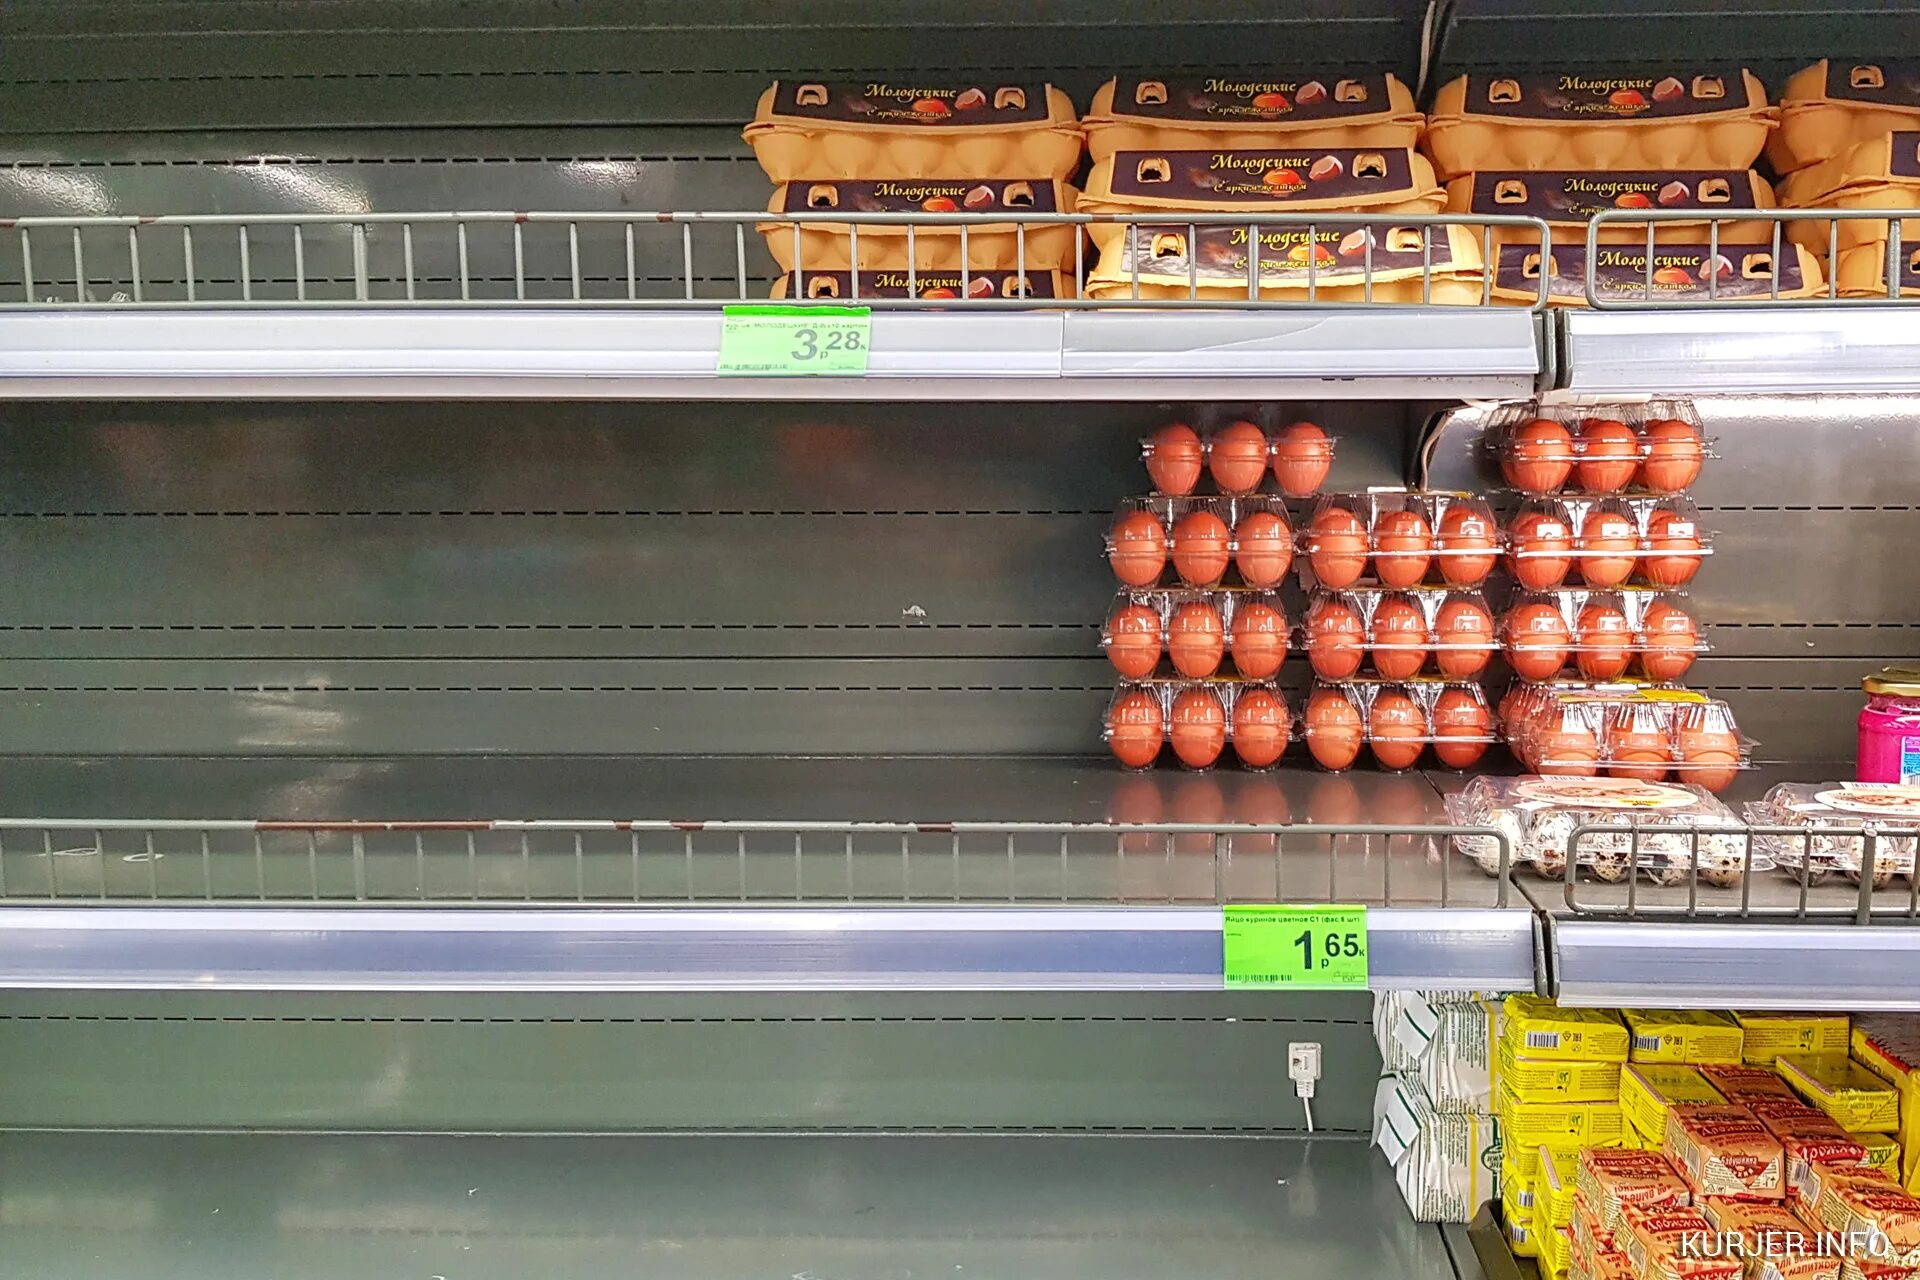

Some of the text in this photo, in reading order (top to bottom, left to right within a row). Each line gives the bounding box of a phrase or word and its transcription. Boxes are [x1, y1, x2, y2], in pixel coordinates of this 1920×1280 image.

[864, 83, 957, 103] Молодецкие
[1204, 78, 1297, 99] Молодецкие
[1558, 76, 1654, 96] Молодецкие
[1209, 154, 1311, 175] Молодецкие
[874, 183, 966, 202] Молодецкие
[1564, 178, 1659, 198] Молодецкие
[791, 329, 818, 361] 3
[820, 351, 829, 360] р
[826, 331, 860, 350] 28
[1225, 916, 1244, 924] Яйцо
[1294, 930, 1312, 969] 1
[1321, 958, 1329, 969] р
[1325, 933, 1359, 957] 65
